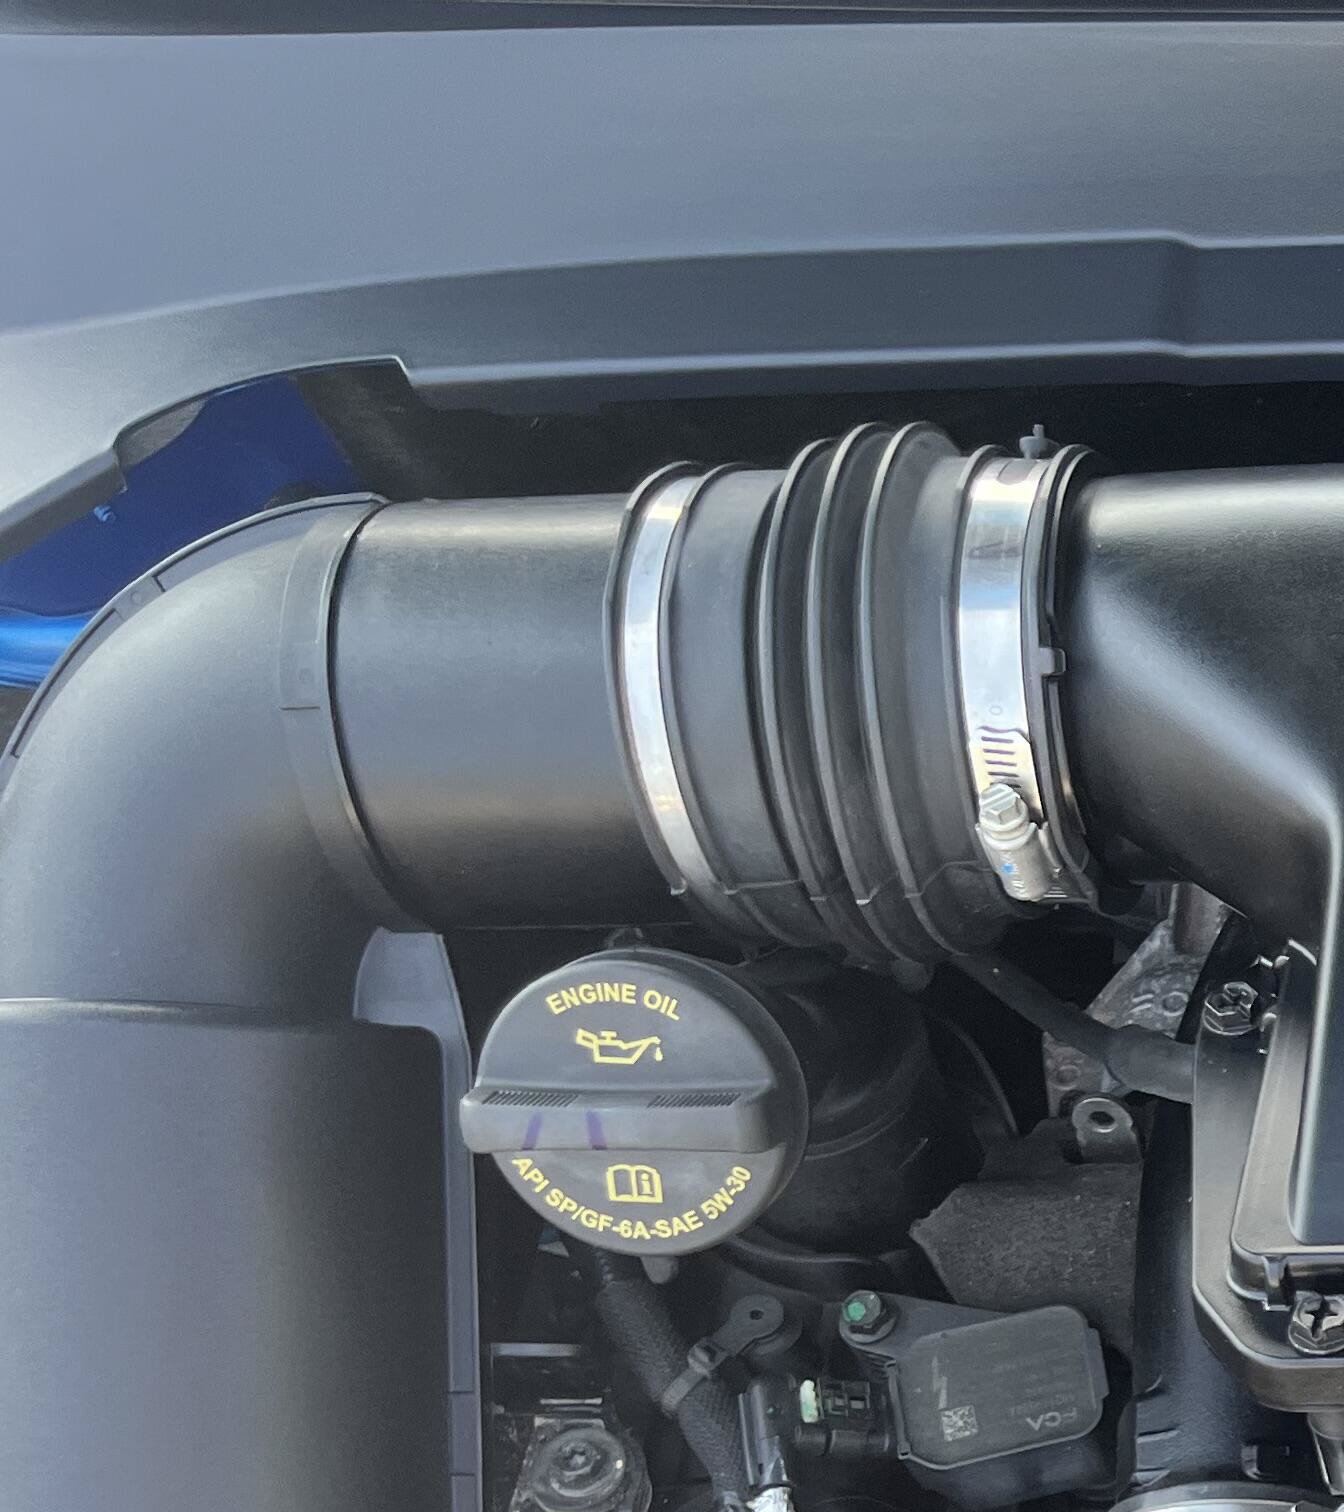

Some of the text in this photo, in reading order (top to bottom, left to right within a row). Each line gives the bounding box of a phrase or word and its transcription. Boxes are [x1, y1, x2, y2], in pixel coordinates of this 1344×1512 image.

[545, 982, 682, 1021] ENGINE OIL
[511, 1155, 754, 1240] API SP/GF-6A-SAE 5W-30
